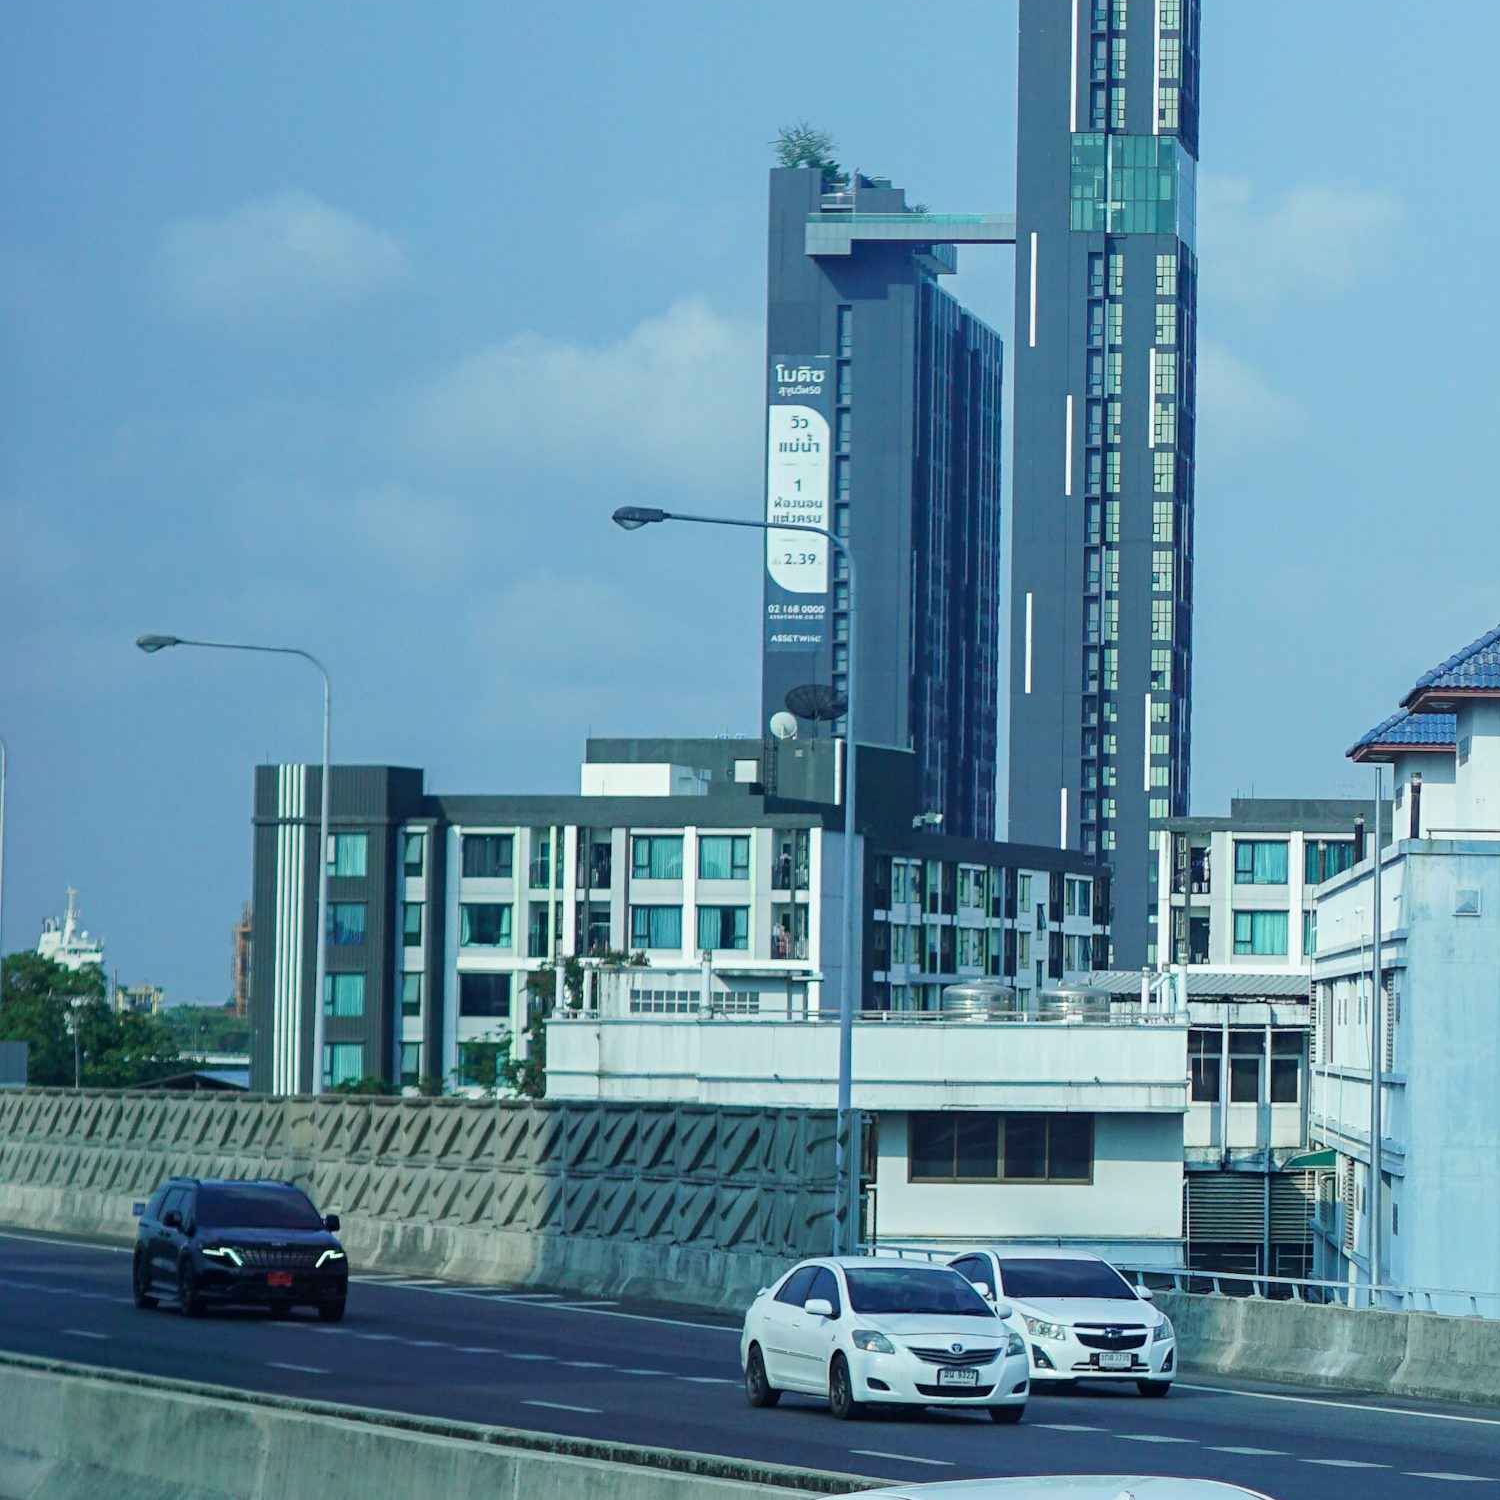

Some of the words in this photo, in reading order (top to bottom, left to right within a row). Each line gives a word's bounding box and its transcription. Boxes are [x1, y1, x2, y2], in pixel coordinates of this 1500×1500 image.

[779, 434, 820, 453] แม่น้ำ
[793, 477, 801, 492] 1
[784, 553, 816, 565] 2.39
[768, 604, 780, 613] 02
[801, 604, 826, 613] 0000
